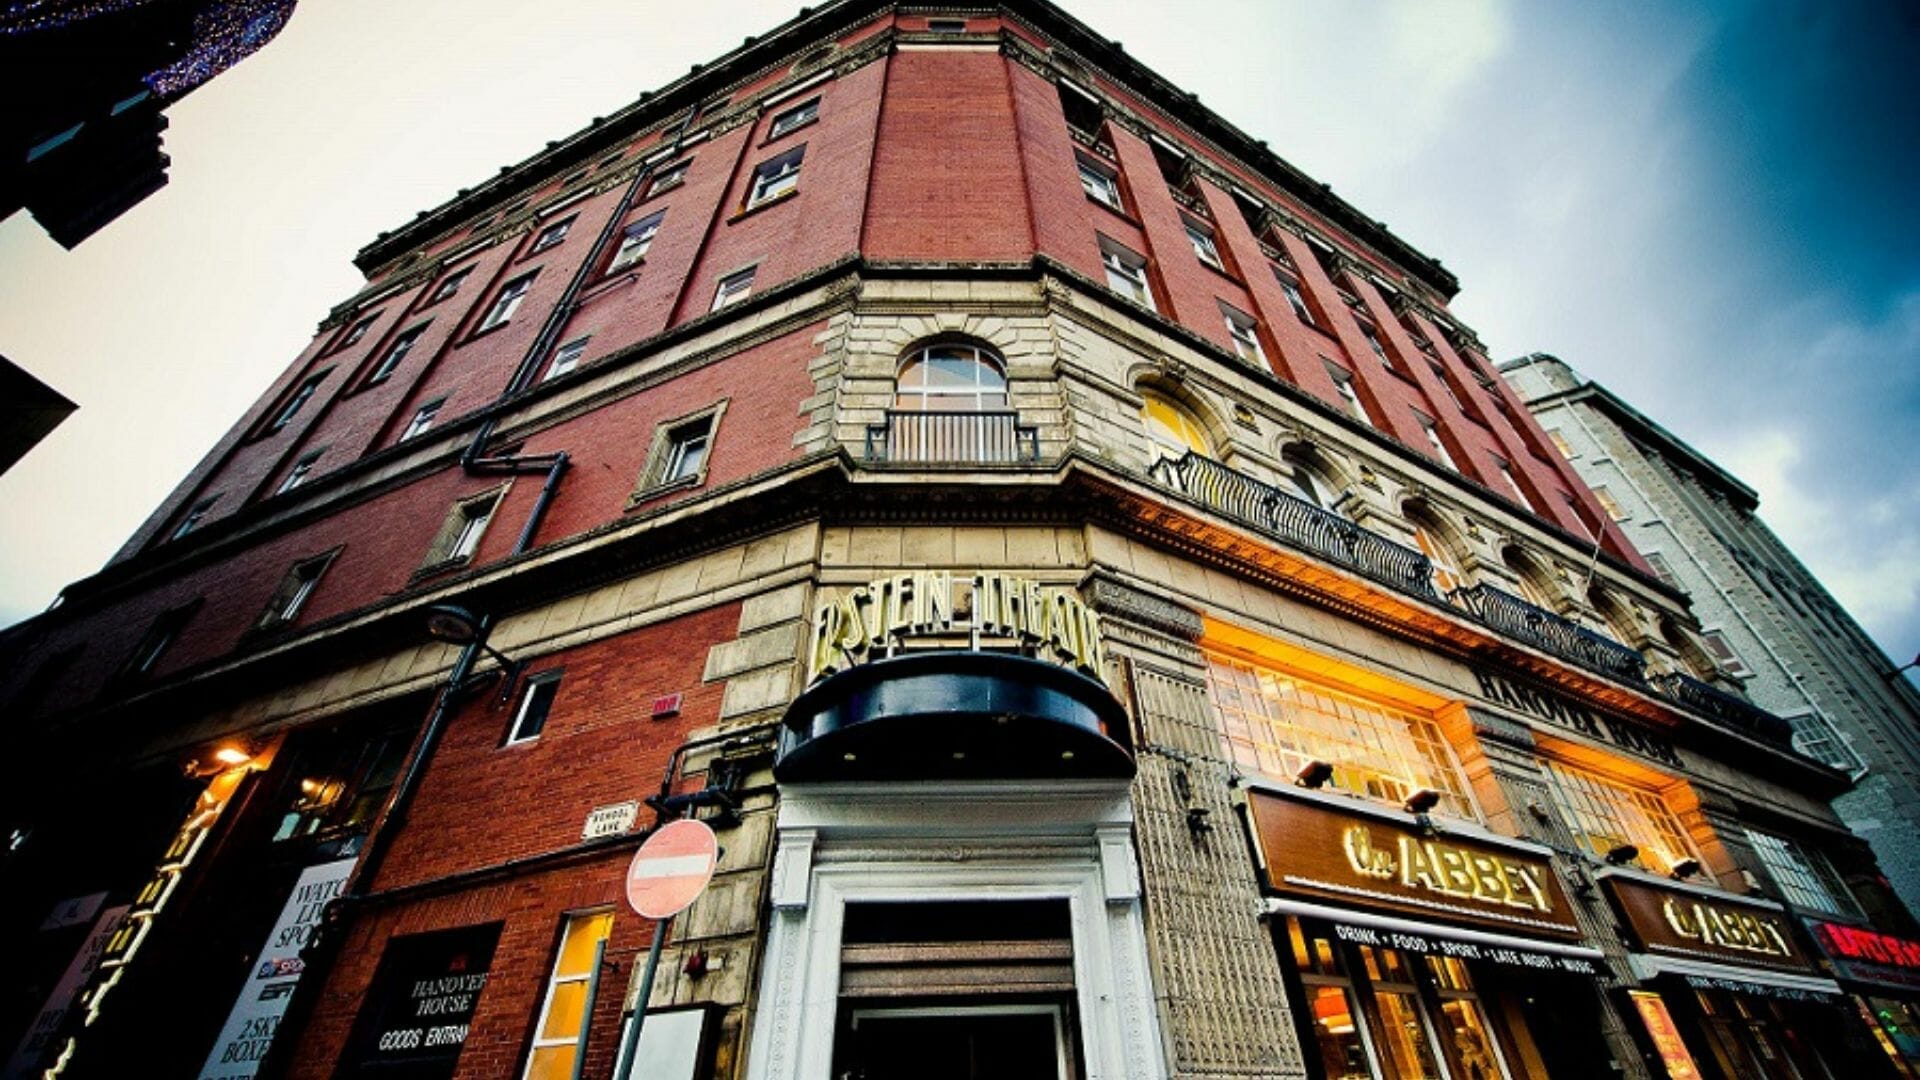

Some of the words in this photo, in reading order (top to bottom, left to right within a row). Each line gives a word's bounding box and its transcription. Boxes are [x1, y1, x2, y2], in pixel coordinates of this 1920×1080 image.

[1397, 834, 1553, 913] ABBEY
[1334, 923, 1382, 945] DRINK
[1391, 932, 1429, 953] FOOD
[1440, 939, 1483, 960] SPORT
[1490, 948, 1523, 967] LATE
[1692, 902, 1792, 957] ABBEY
[416, 993, 472, 1016] HOUSE
[379, 1028, 423, 1050] GOODS
